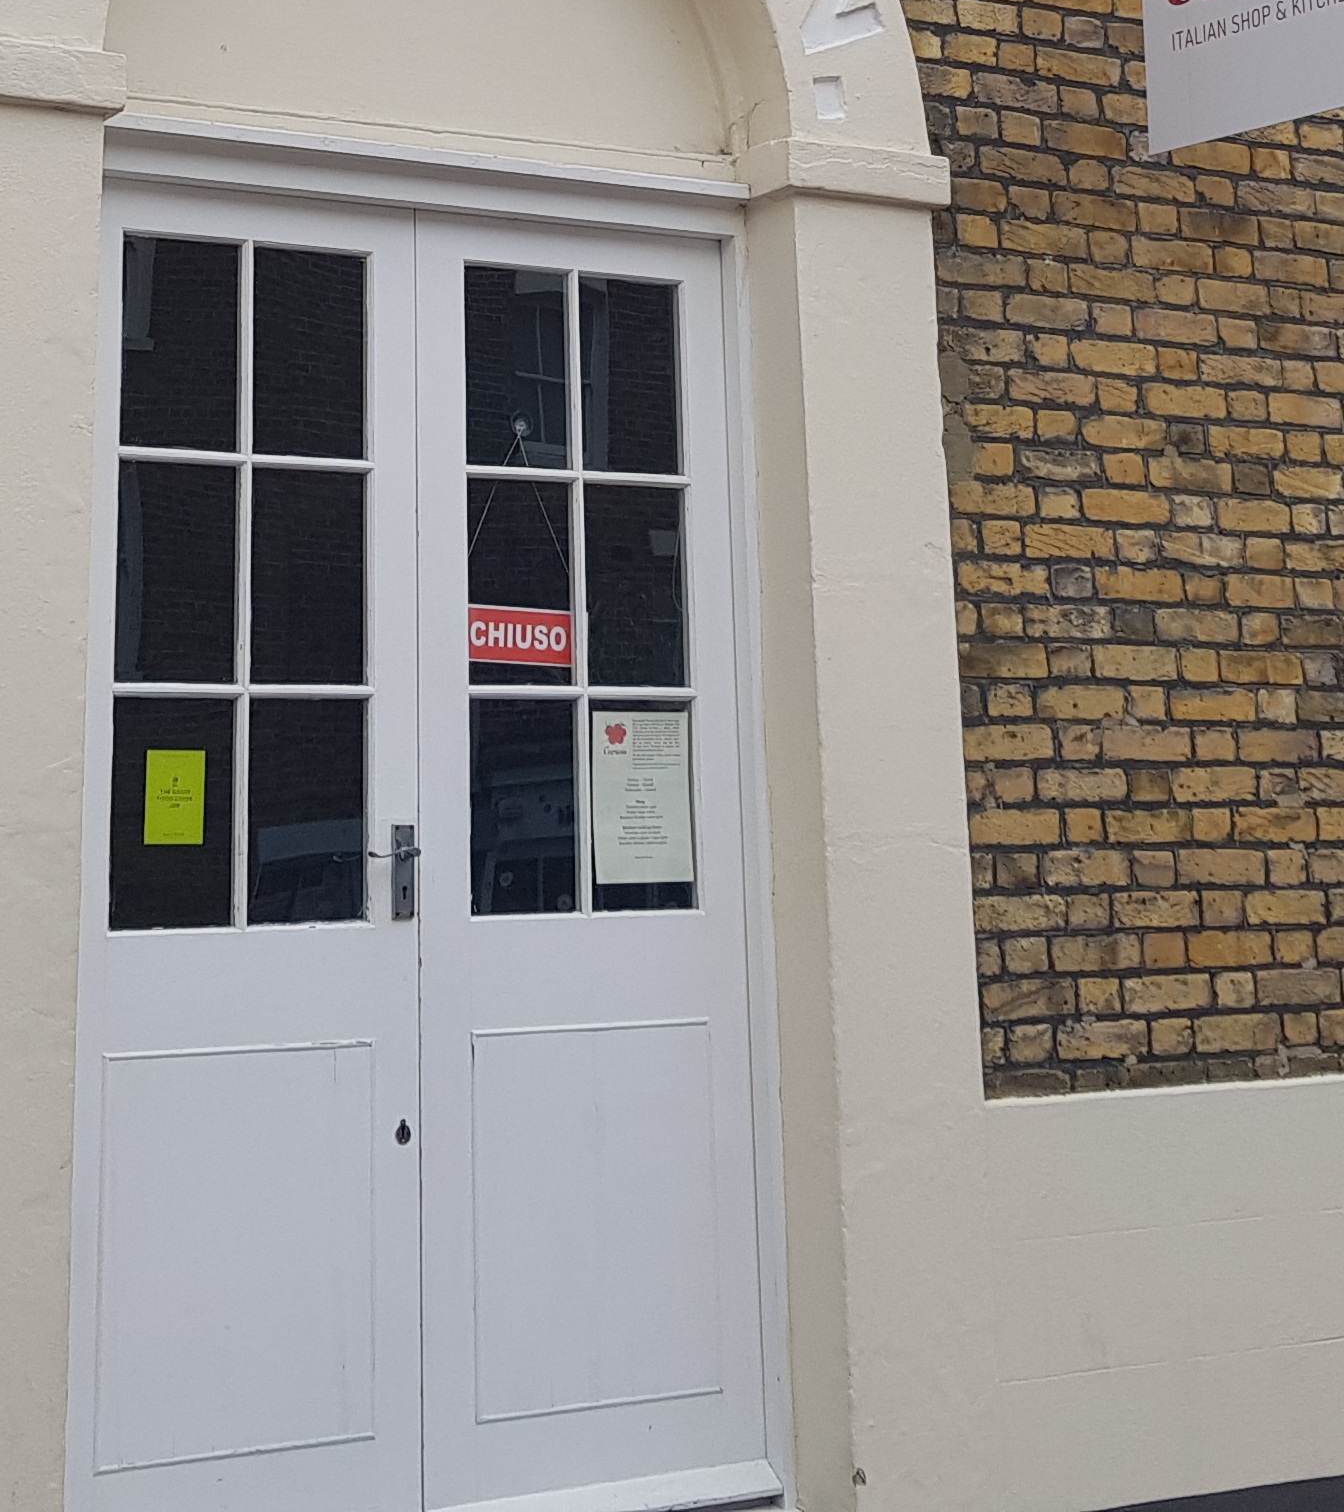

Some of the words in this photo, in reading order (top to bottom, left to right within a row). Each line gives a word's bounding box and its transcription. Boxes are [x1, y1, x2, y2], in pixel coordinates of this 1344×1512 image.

[1171, 18, 1227, 52] ITALIAN
[1231, 4, 1271, 35] SHOP
[1275, 0, 1287, 21] &
[469, 620, 567, 652] CHIUSO
